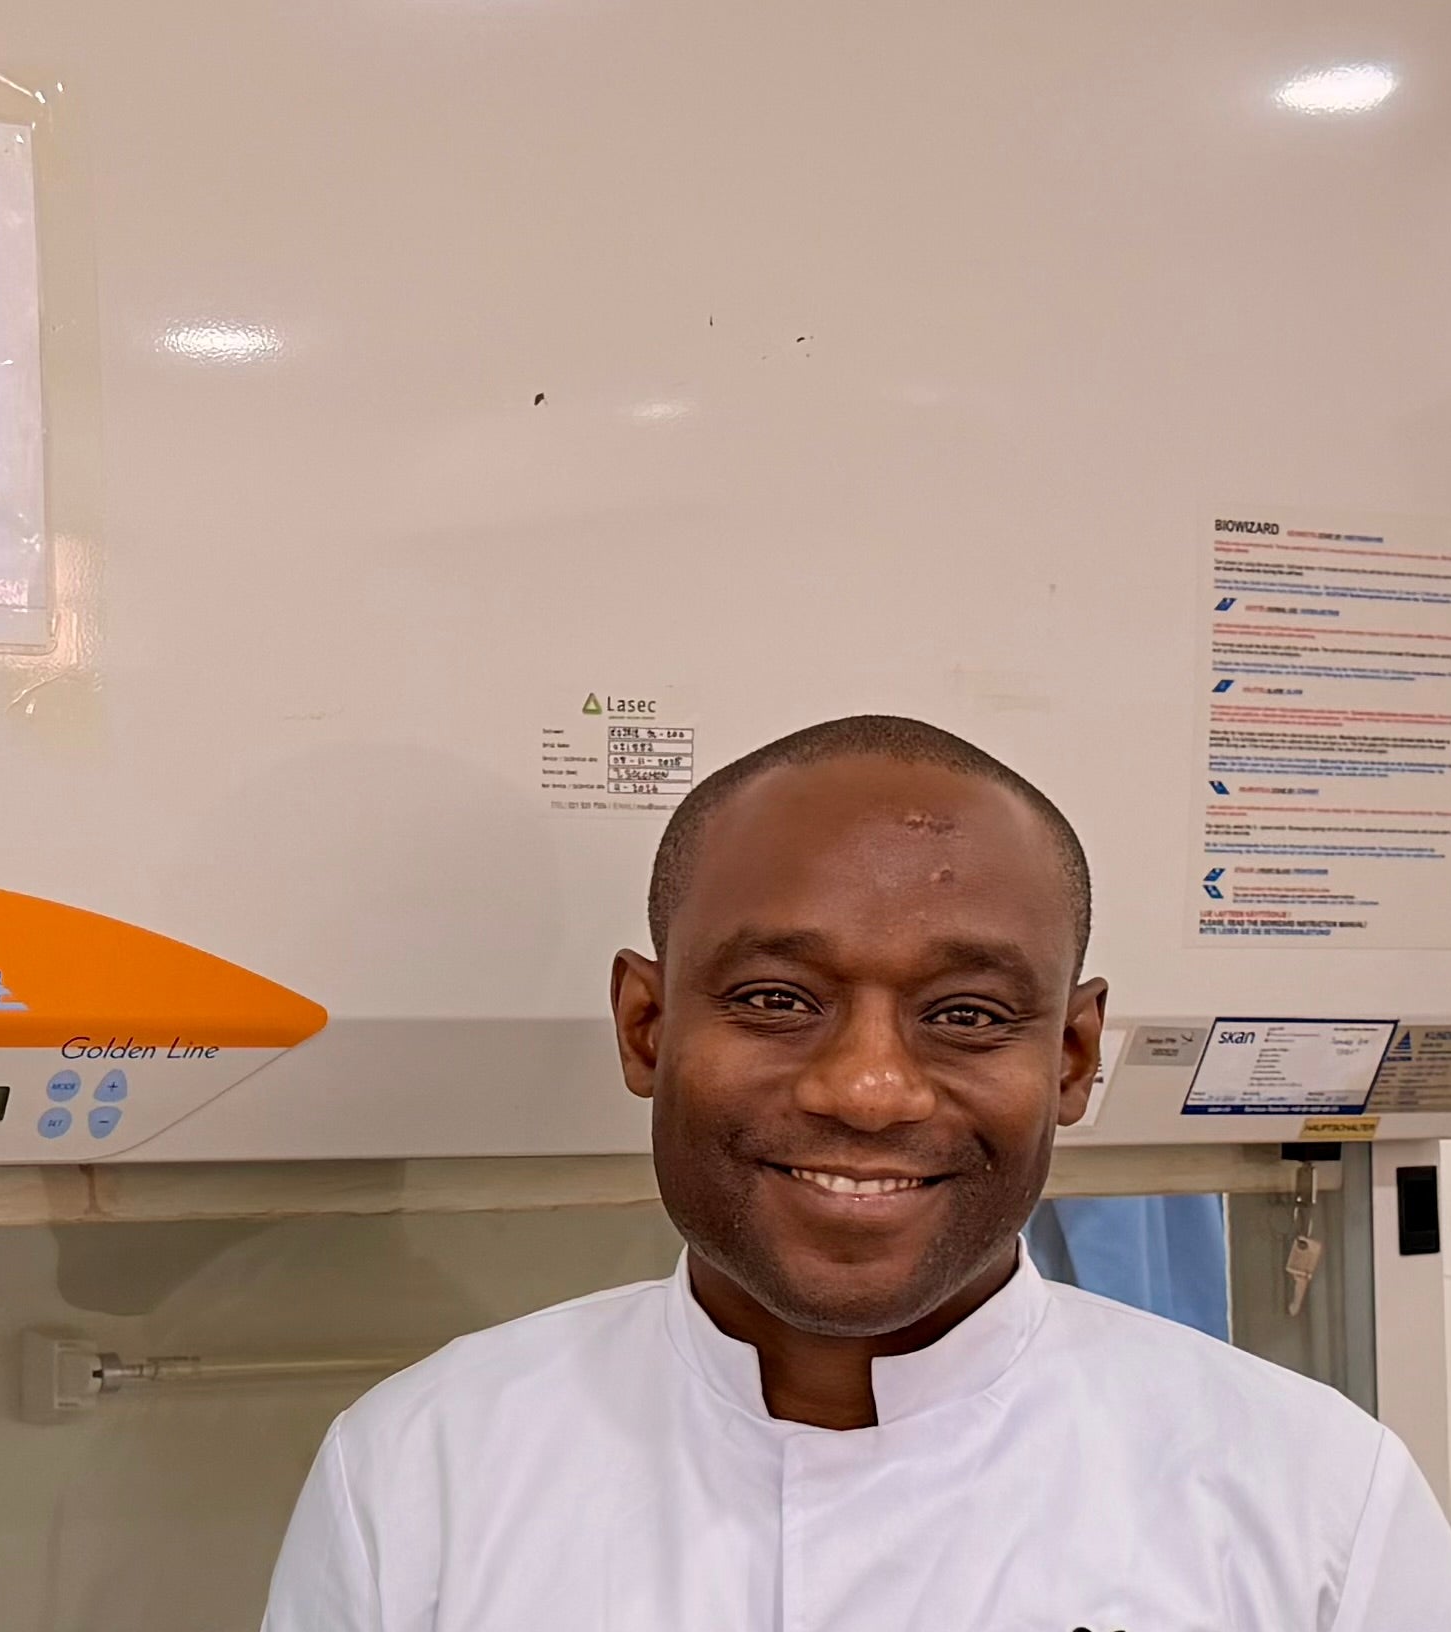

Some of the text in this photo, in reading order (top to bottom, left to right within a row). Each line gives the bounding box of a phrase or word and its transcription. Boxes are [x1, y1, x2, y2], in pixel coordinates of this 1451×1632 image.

[1214, 519, 1280, 536] BIOWIZARD
[606, 695, 657, 714] Lasec
[1218, 1030, 1256, 1045] skan
[61, 1036, 220, 1060] Golden Line
